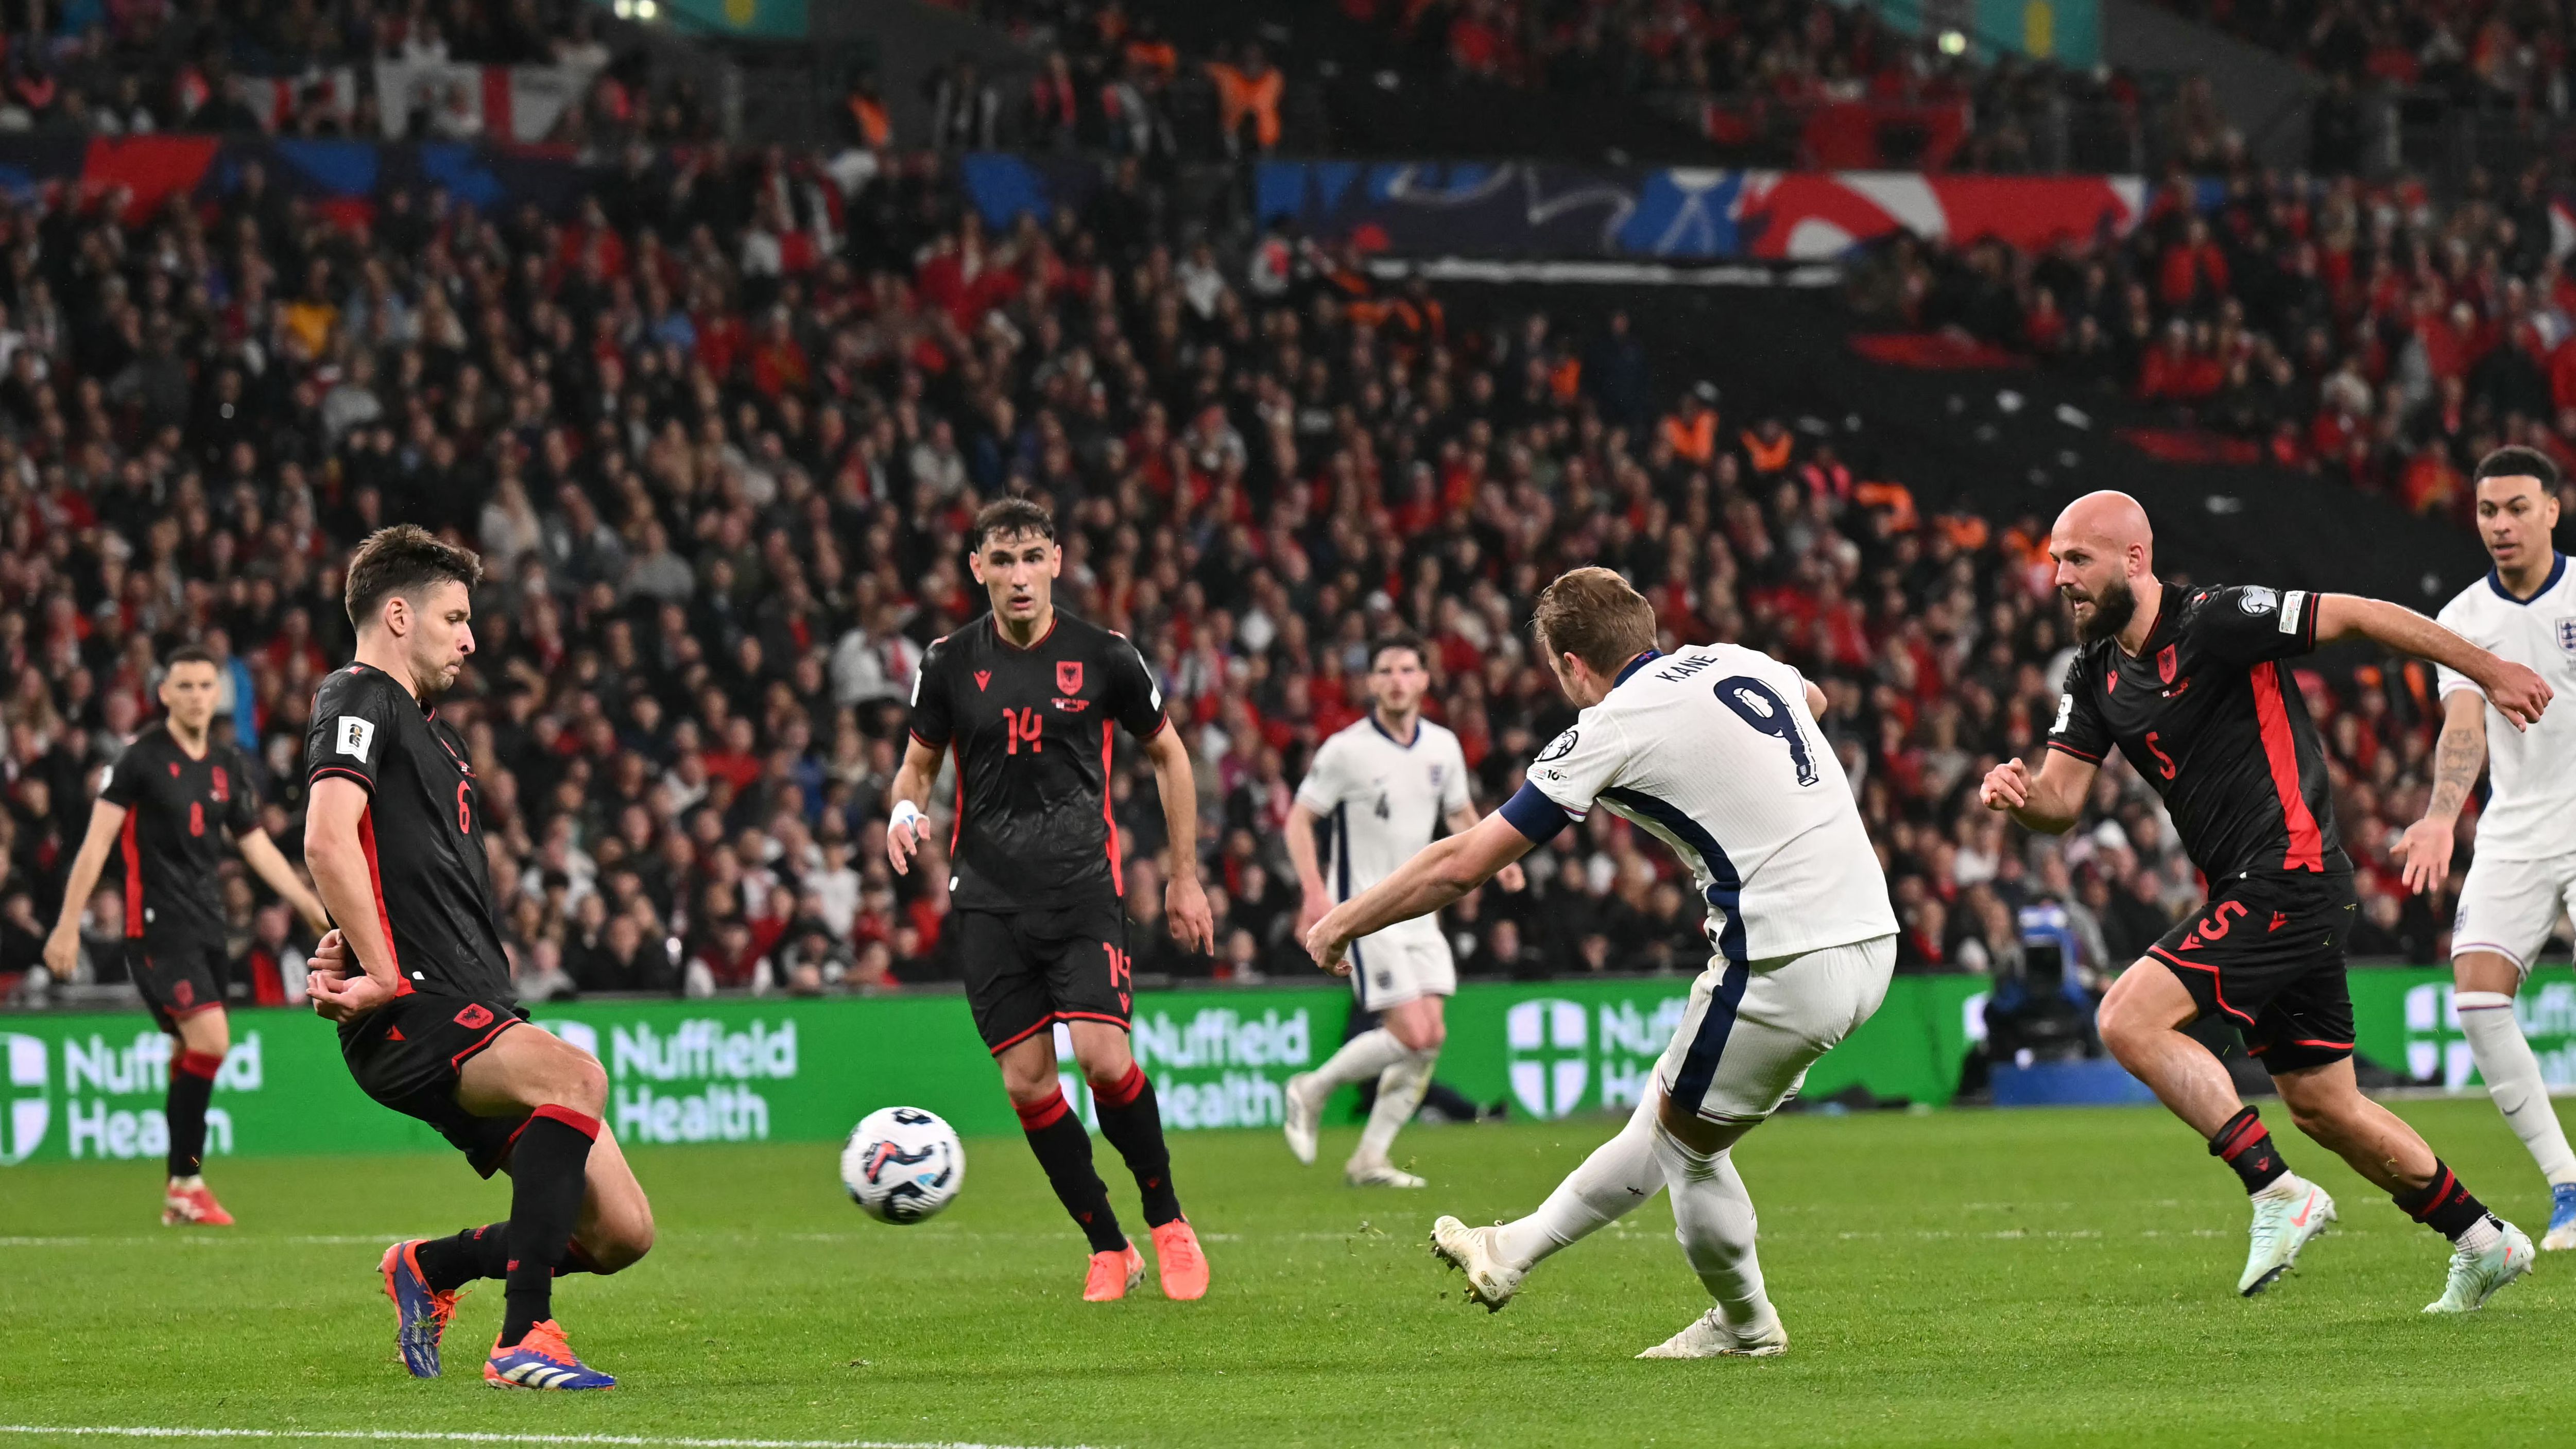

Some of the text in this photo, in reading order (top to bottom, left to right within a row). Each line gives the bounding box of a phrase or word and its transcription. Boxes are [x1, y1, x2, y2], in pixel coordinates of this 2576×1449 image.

[1655, 655, 1718, 682] KANE
[1003, 707, 1042, 755] 14
[1713, 676, 1819, 787] 9
[2145, 731, 2176, 780] 5
[457, 780, 471, 834] 6
[1375, 791, 1389, 820] 4
[2199, 900, 2248, 940] 5
[1103, 942, 1132, 992] 14
[63, 1031, 263, 1094] Nuffd
[611, 1018, 797, 1080] Nuffield
[1132, 1007, 1311, 1068] Nuffield
[67, 1097, 233, 1160] Heah
[614, 1083, 769, 1143] Health
